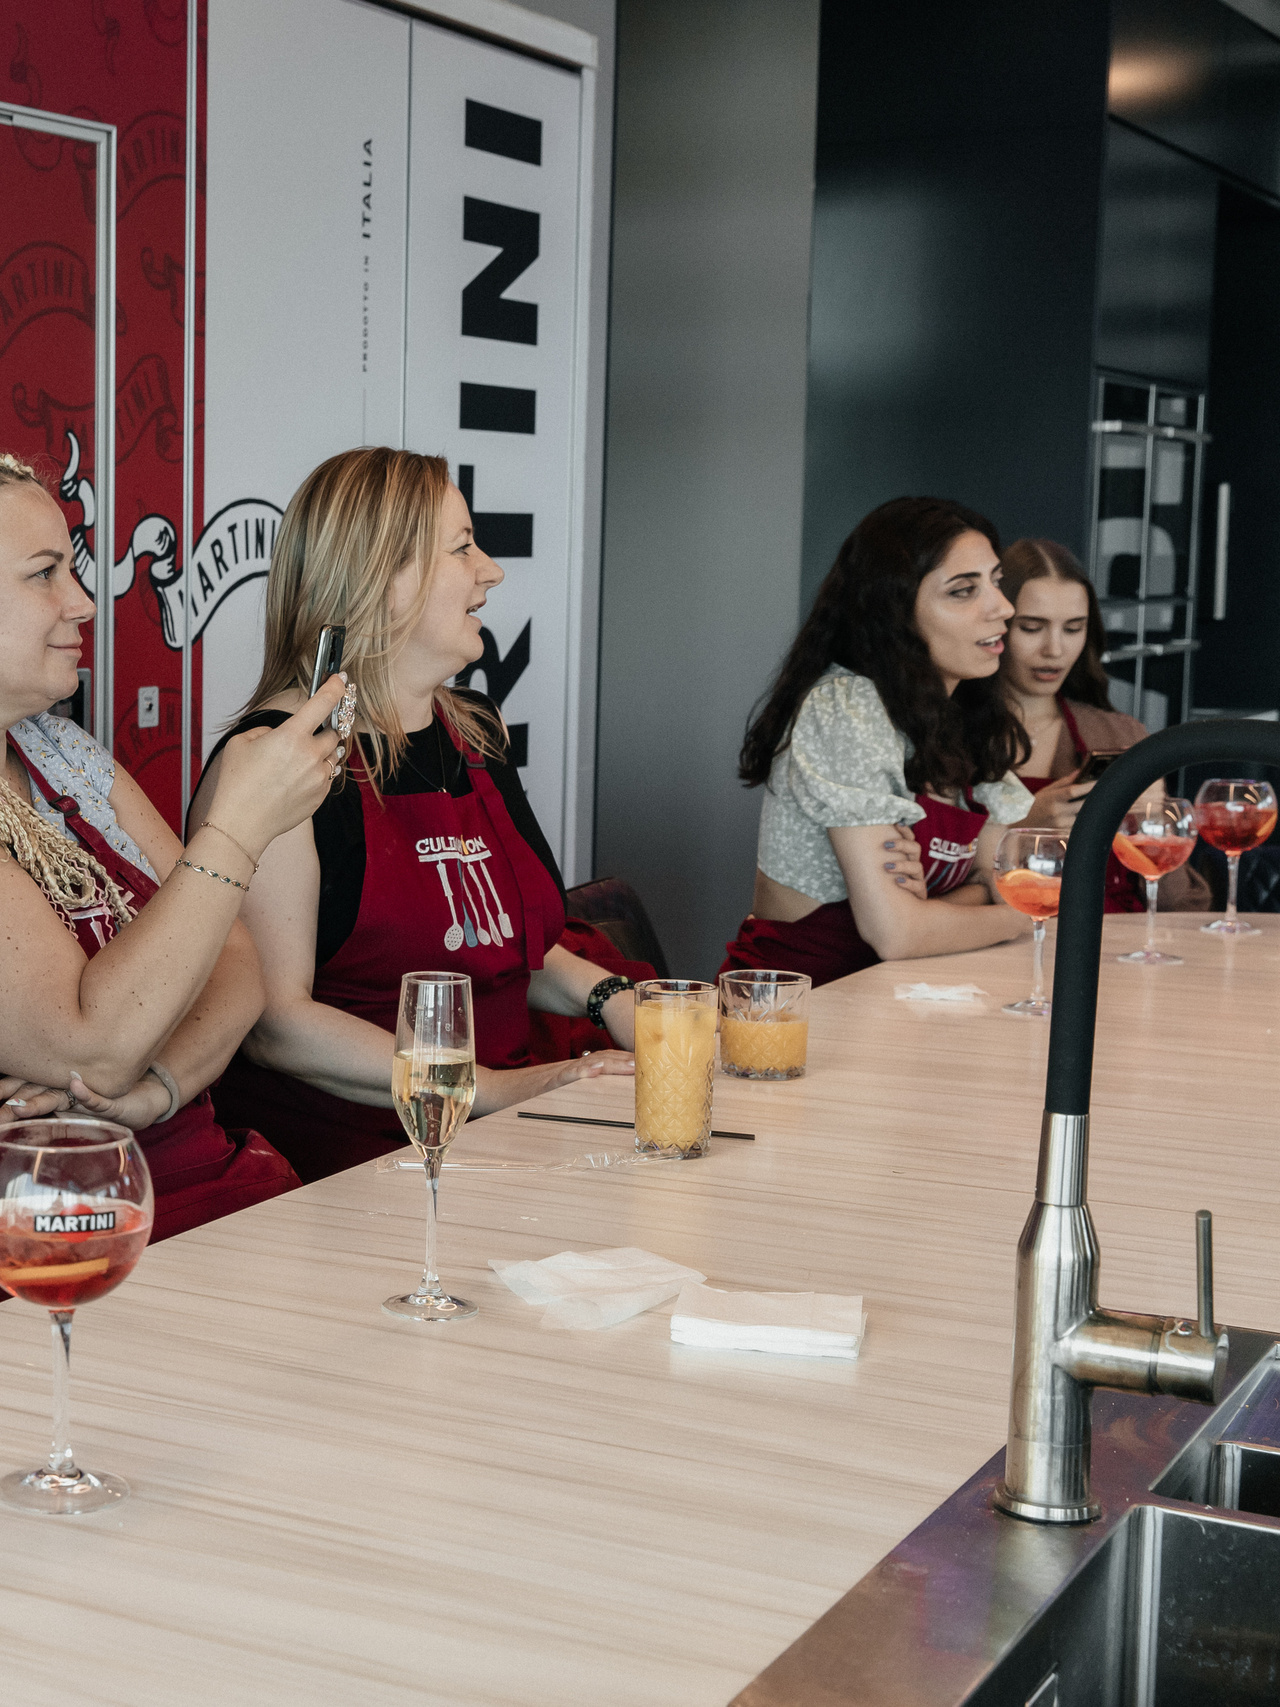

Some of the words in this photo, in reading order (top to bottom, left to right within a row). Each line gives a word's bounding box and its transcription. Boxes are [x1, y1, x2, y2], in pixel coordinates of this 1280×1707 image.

[361, 138, 373, 239] ITALIA
[364, 255, 370, 273] IN
[362, 281, 370, 373] PRODOTTO
[456, 97, 543, 768] RTINI
[35, 1212, 114, 1232] MARTINI
